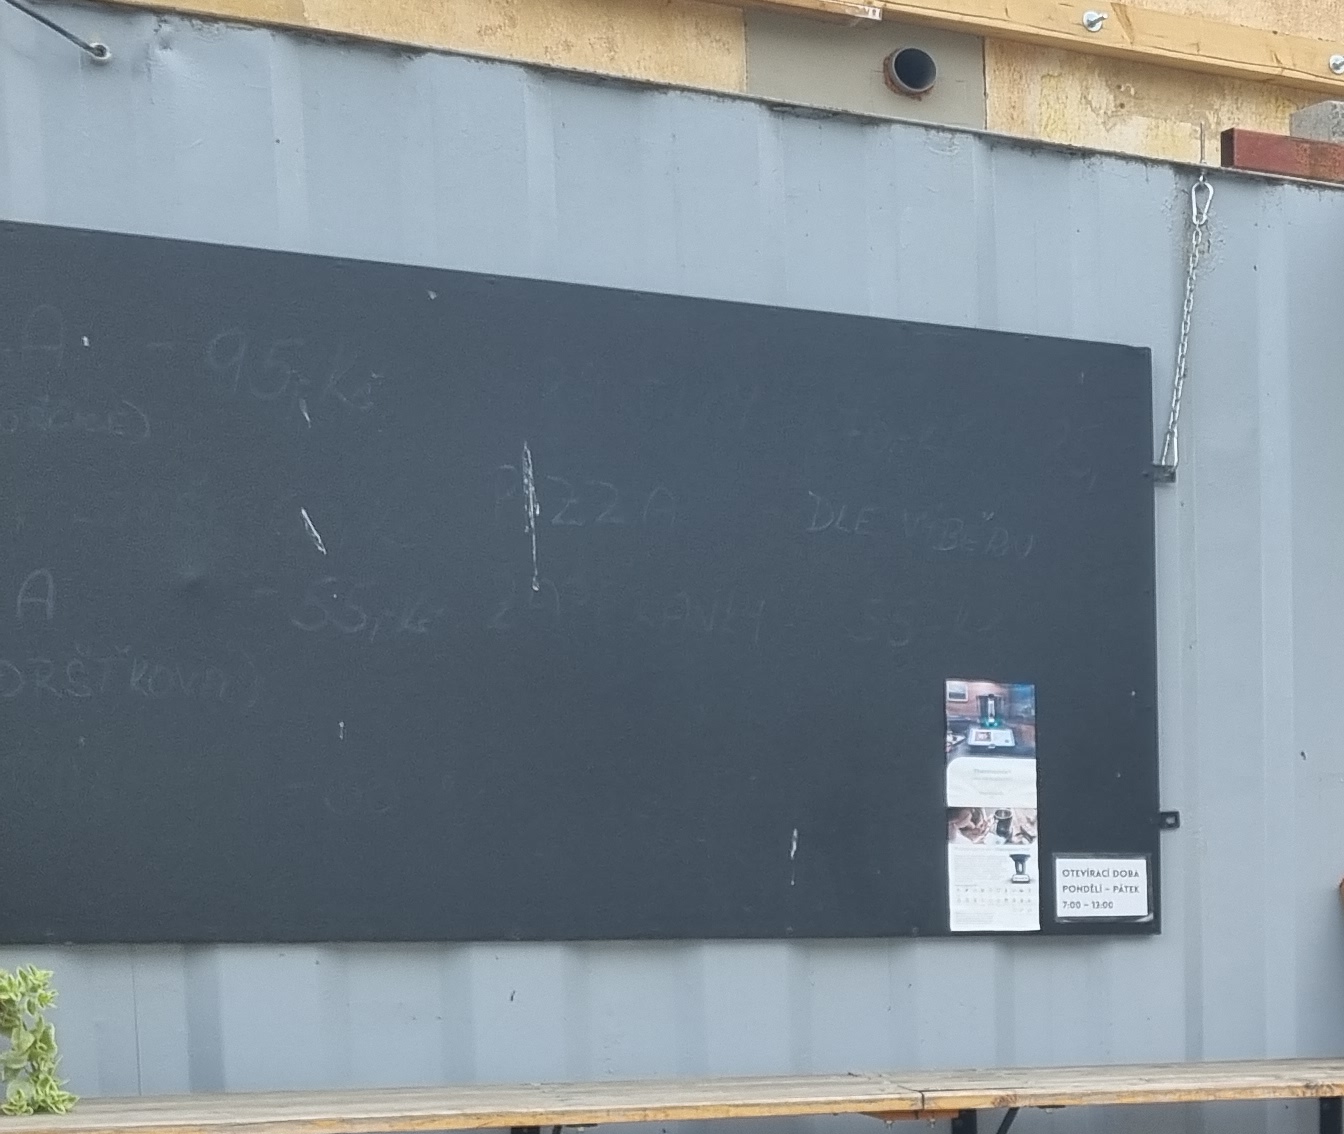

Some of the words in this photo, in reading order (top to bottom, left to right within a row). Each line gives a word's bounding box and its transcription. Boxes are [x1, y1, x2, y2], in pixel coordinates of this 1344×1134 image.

[1062, 867, 1110, 878] OTEVÍRACÍ
[1112, 869, 1140, 878] DOBA
[1062, 883, 1102, 893] PONDĚLÍ
[1113, 883, 1140, 893] PÁTEK
